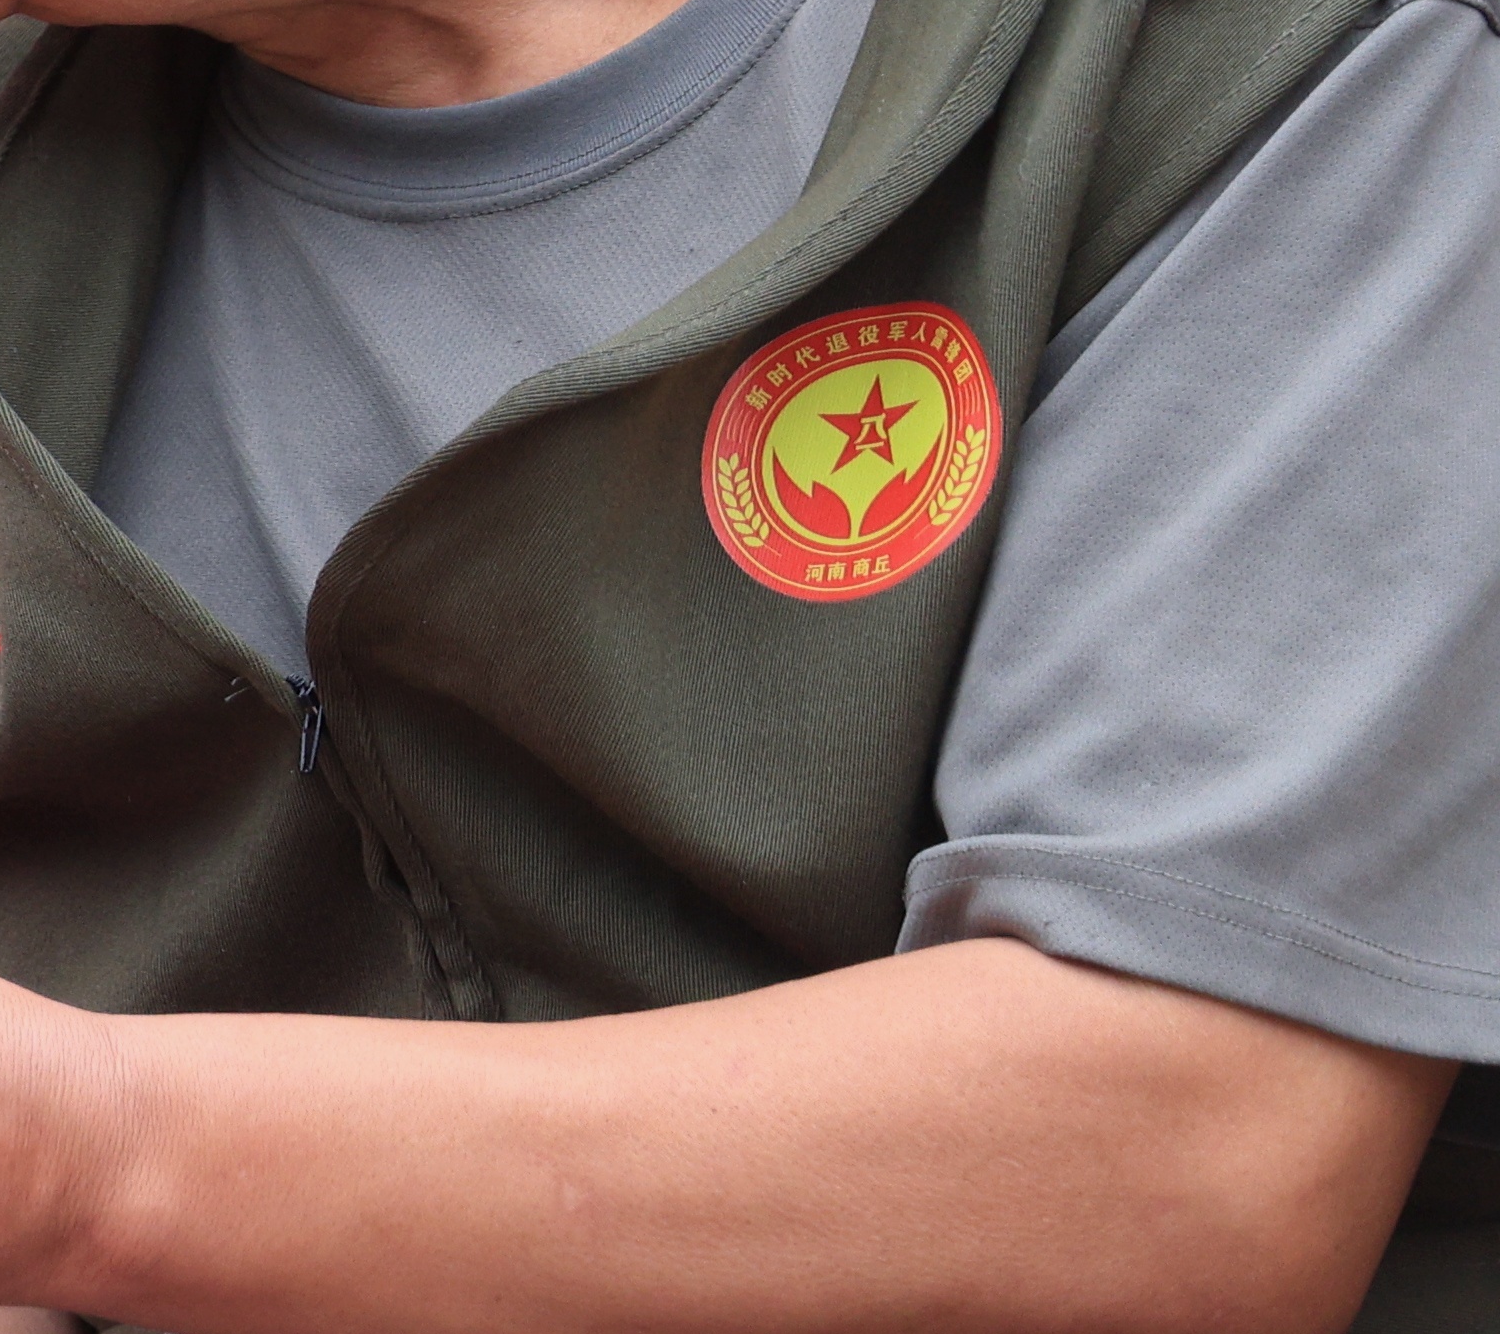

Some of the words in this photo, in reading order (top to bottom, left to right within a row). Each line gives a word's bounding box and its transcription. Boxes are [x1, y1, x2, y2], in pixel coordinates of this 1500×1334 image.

[745, 320, 974, 412] 新时代退役军人雷锋团
[804, 562, 846, 582] 河南
[851, 554, 891, 578] 商丘
